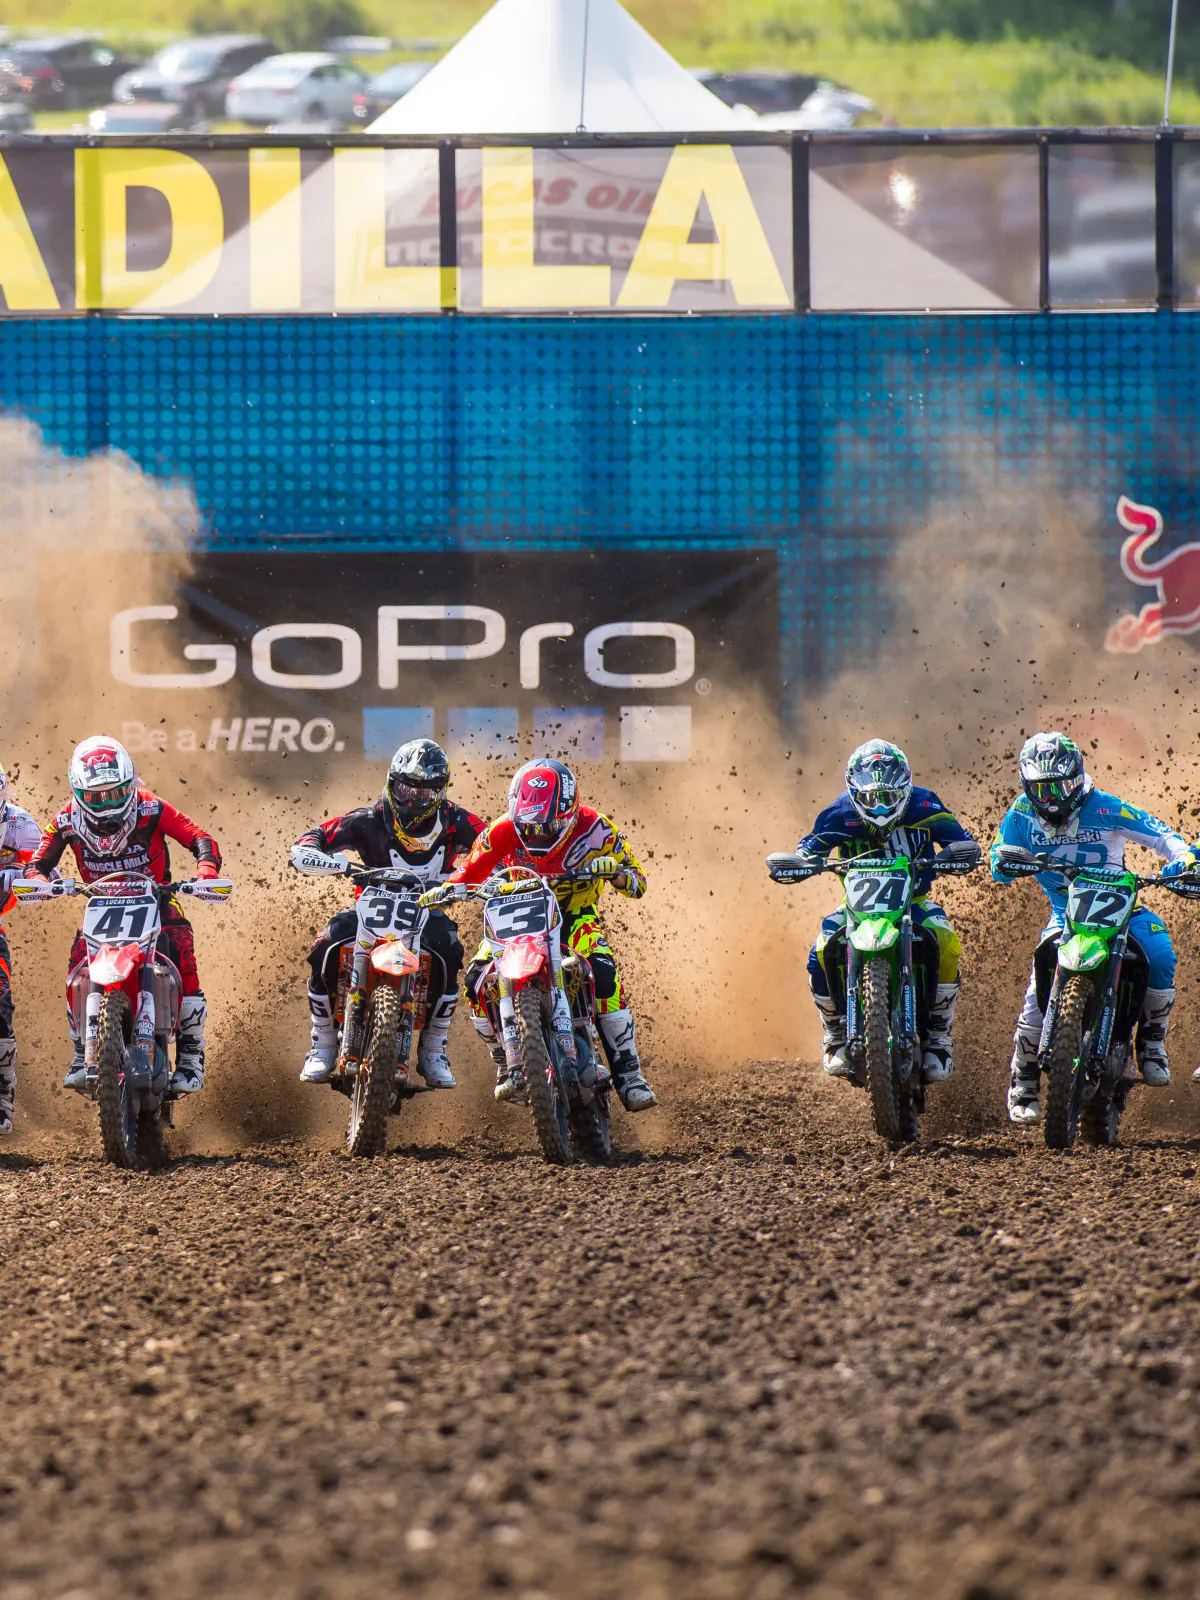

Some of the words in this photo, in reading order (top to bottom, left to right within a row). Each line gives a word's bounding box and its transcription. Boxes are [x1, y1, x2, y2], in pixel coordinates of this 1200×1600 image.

[419, 177, 578, 216] LUCAS
[110, 603, 695, 690] GoPro
[121, 720, 168, 753] Be
[176, 728, 197, 753] a
[207, 716, 346, 753] HERO.
[1030, 830, 1101, 847] Kawasaki
[84, 860, 123, 873] MUSCLE
[124, 853, 150, 870] MILK
[302, 857, 341, 870] GALFER
[105, 898, 125, 906] LUCAS
[502, 896, 522, 904] LUCAS
[853, 878, 906, 912] 24
[1072, 890, 1127, 928] 12
[92, 907, 148, 939] 41
[365, 898, 420, 931] 39
[495, 899, 546, 939] 3
